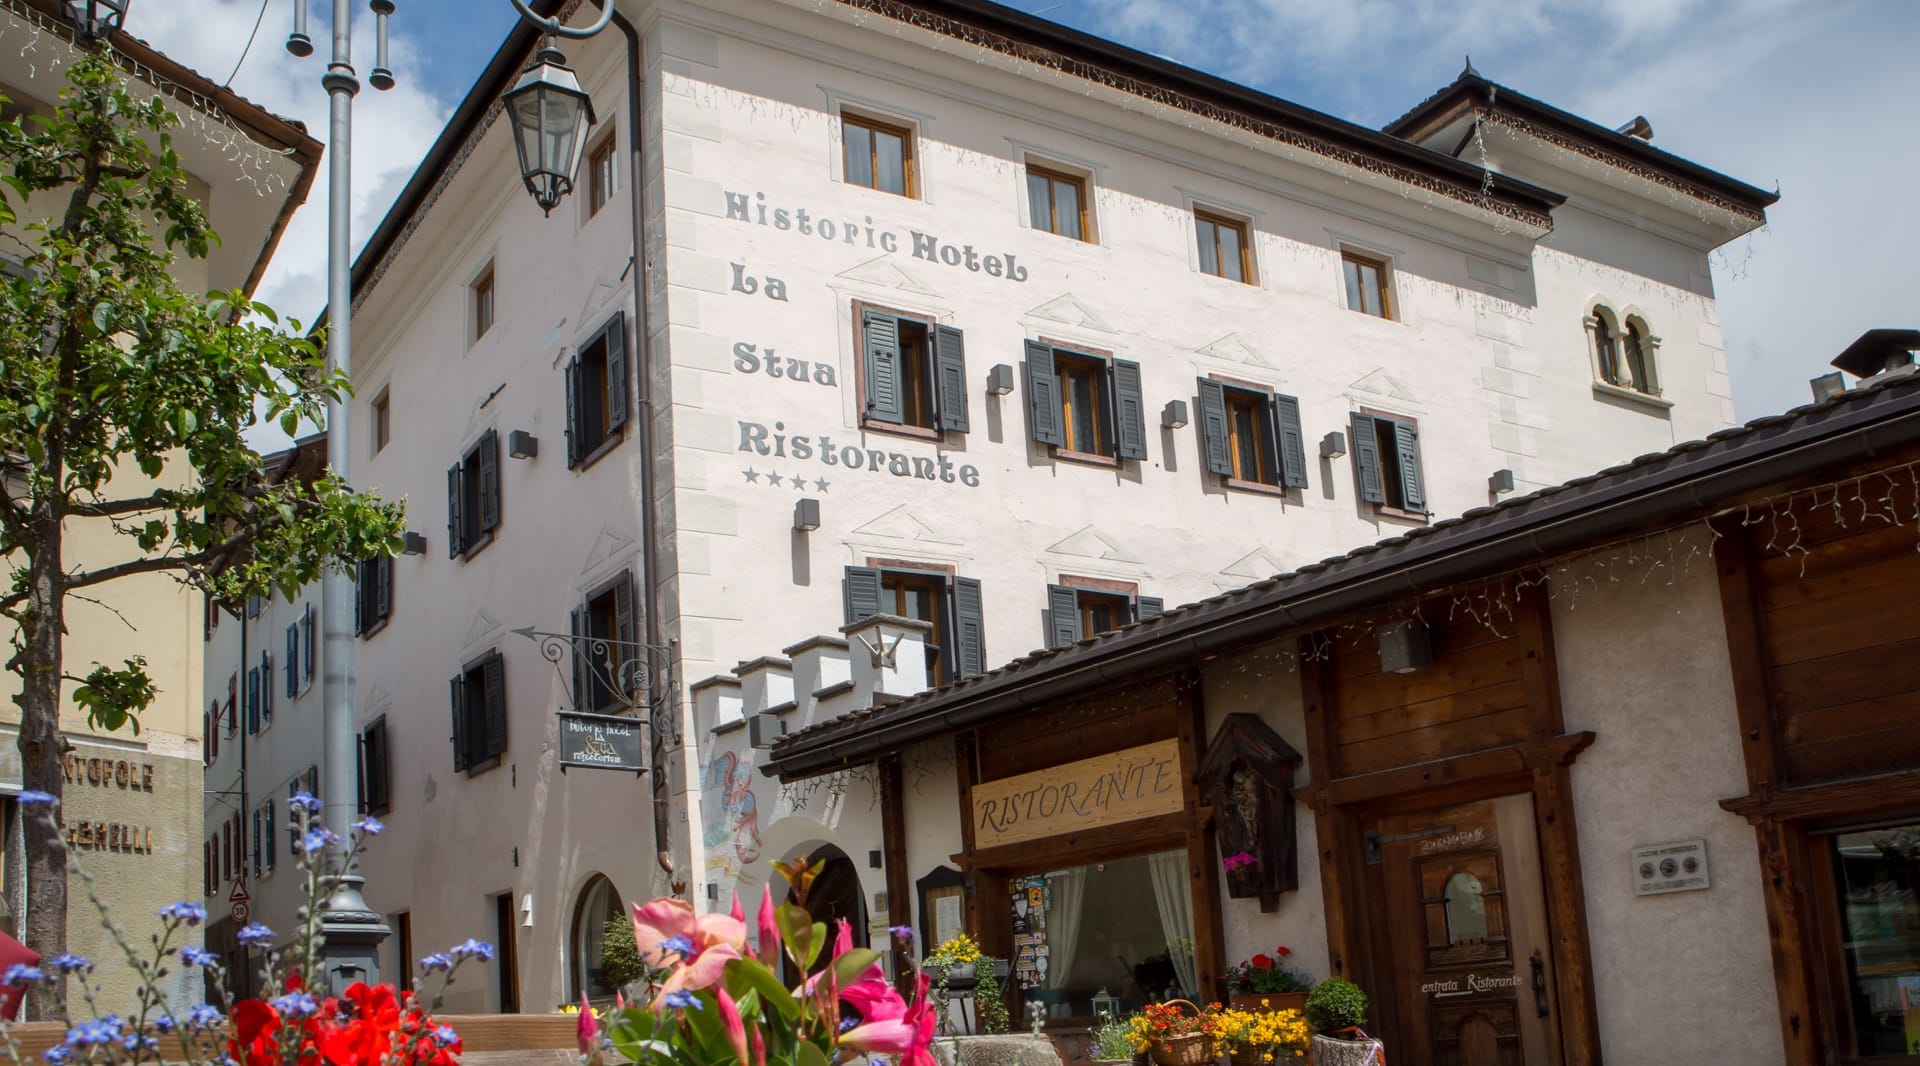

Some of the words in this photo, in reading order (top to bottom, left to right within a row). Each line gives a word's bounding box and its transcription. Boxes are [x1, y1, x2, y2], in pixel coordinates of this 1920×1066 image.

[724, 190, 898, 253] Historic
[730, 262, 788, 302] La
[733, 342, 838, 387] Stua
[738, 420, 980, 487] Ristorante
[979, 757, 1175, 833] RISTORANTE
[1422, 980, 1458, 993] entrata
[1467, 973, 1523, 992] Ristorante
